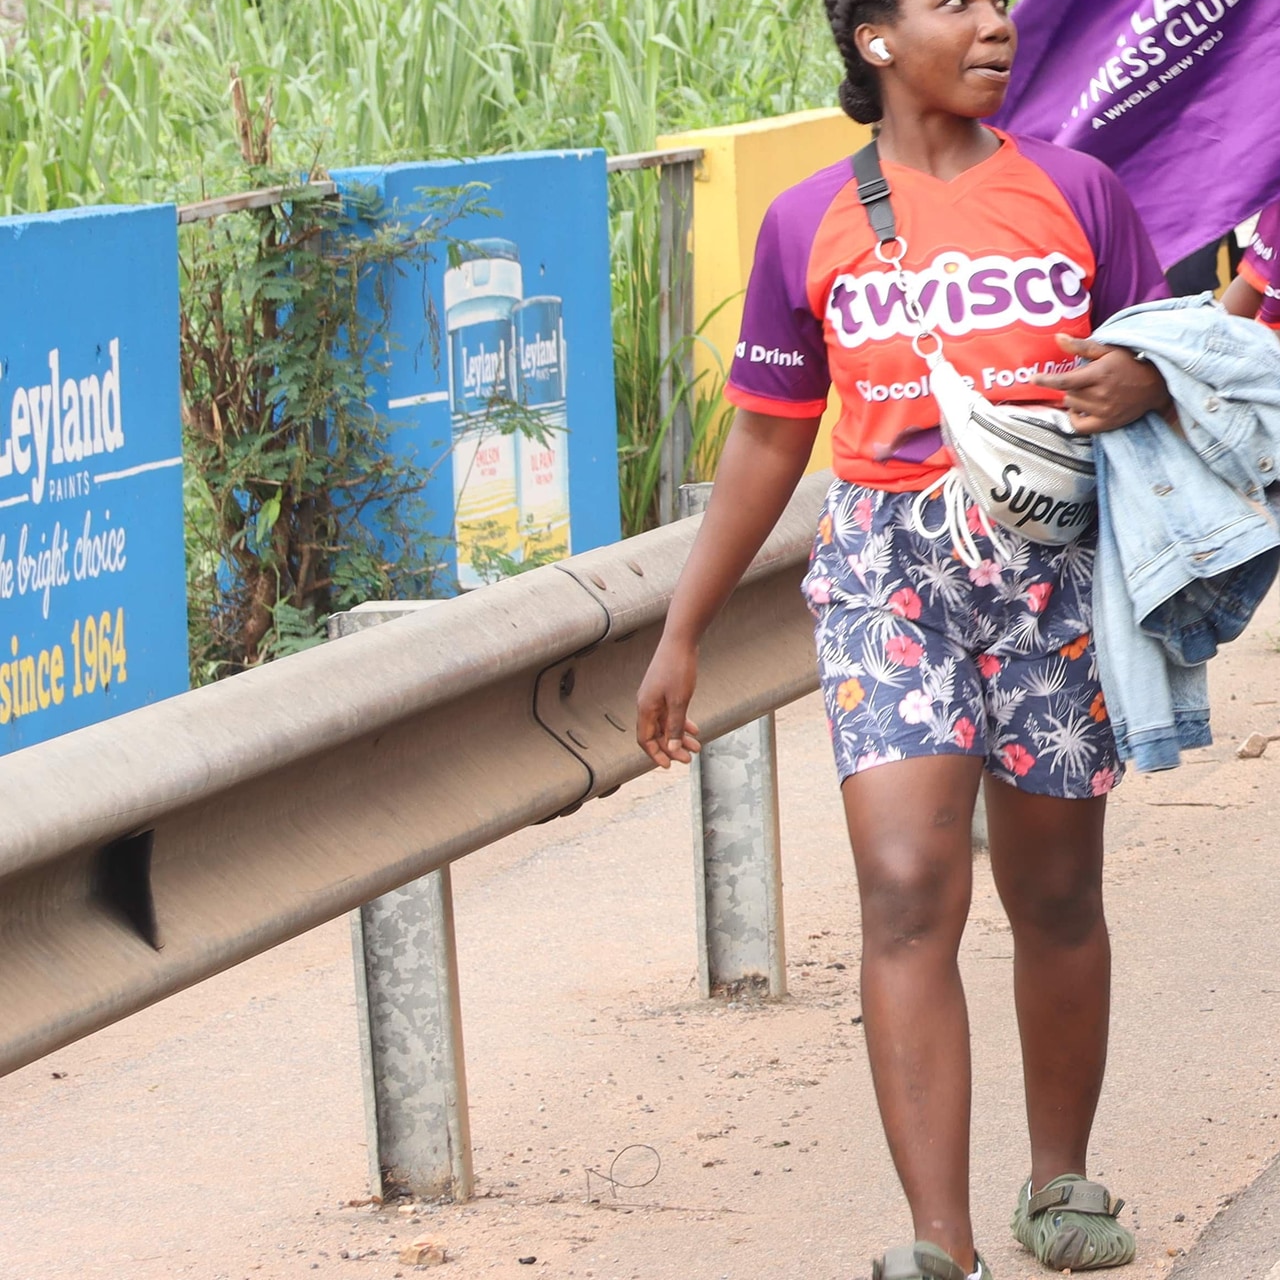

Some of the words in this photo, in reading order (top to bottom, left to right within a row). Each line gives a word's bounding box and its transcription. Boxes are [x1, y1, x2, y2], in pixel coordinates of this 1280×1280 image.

[1091, 114, 1107, 130] A
[1103, 80, 1162, 122] WHOLE
[1158, 54, 1195, 84] NEW
[1191, 29, 1224, 58] YOU
[829, 258, 1089, 337] twisco
[461, 338, 507, 398] Leyland
[519, 328, 558, 377] Leyland
[750, 347, 805, 368] Drink
[48, 469, 91, 503] PAINTS
[17, 520, 71, 620] bright
[73, 509, 127, 583] choice
[0, 634, 65, 723] since
[70, 606, 127, 697] 1964
